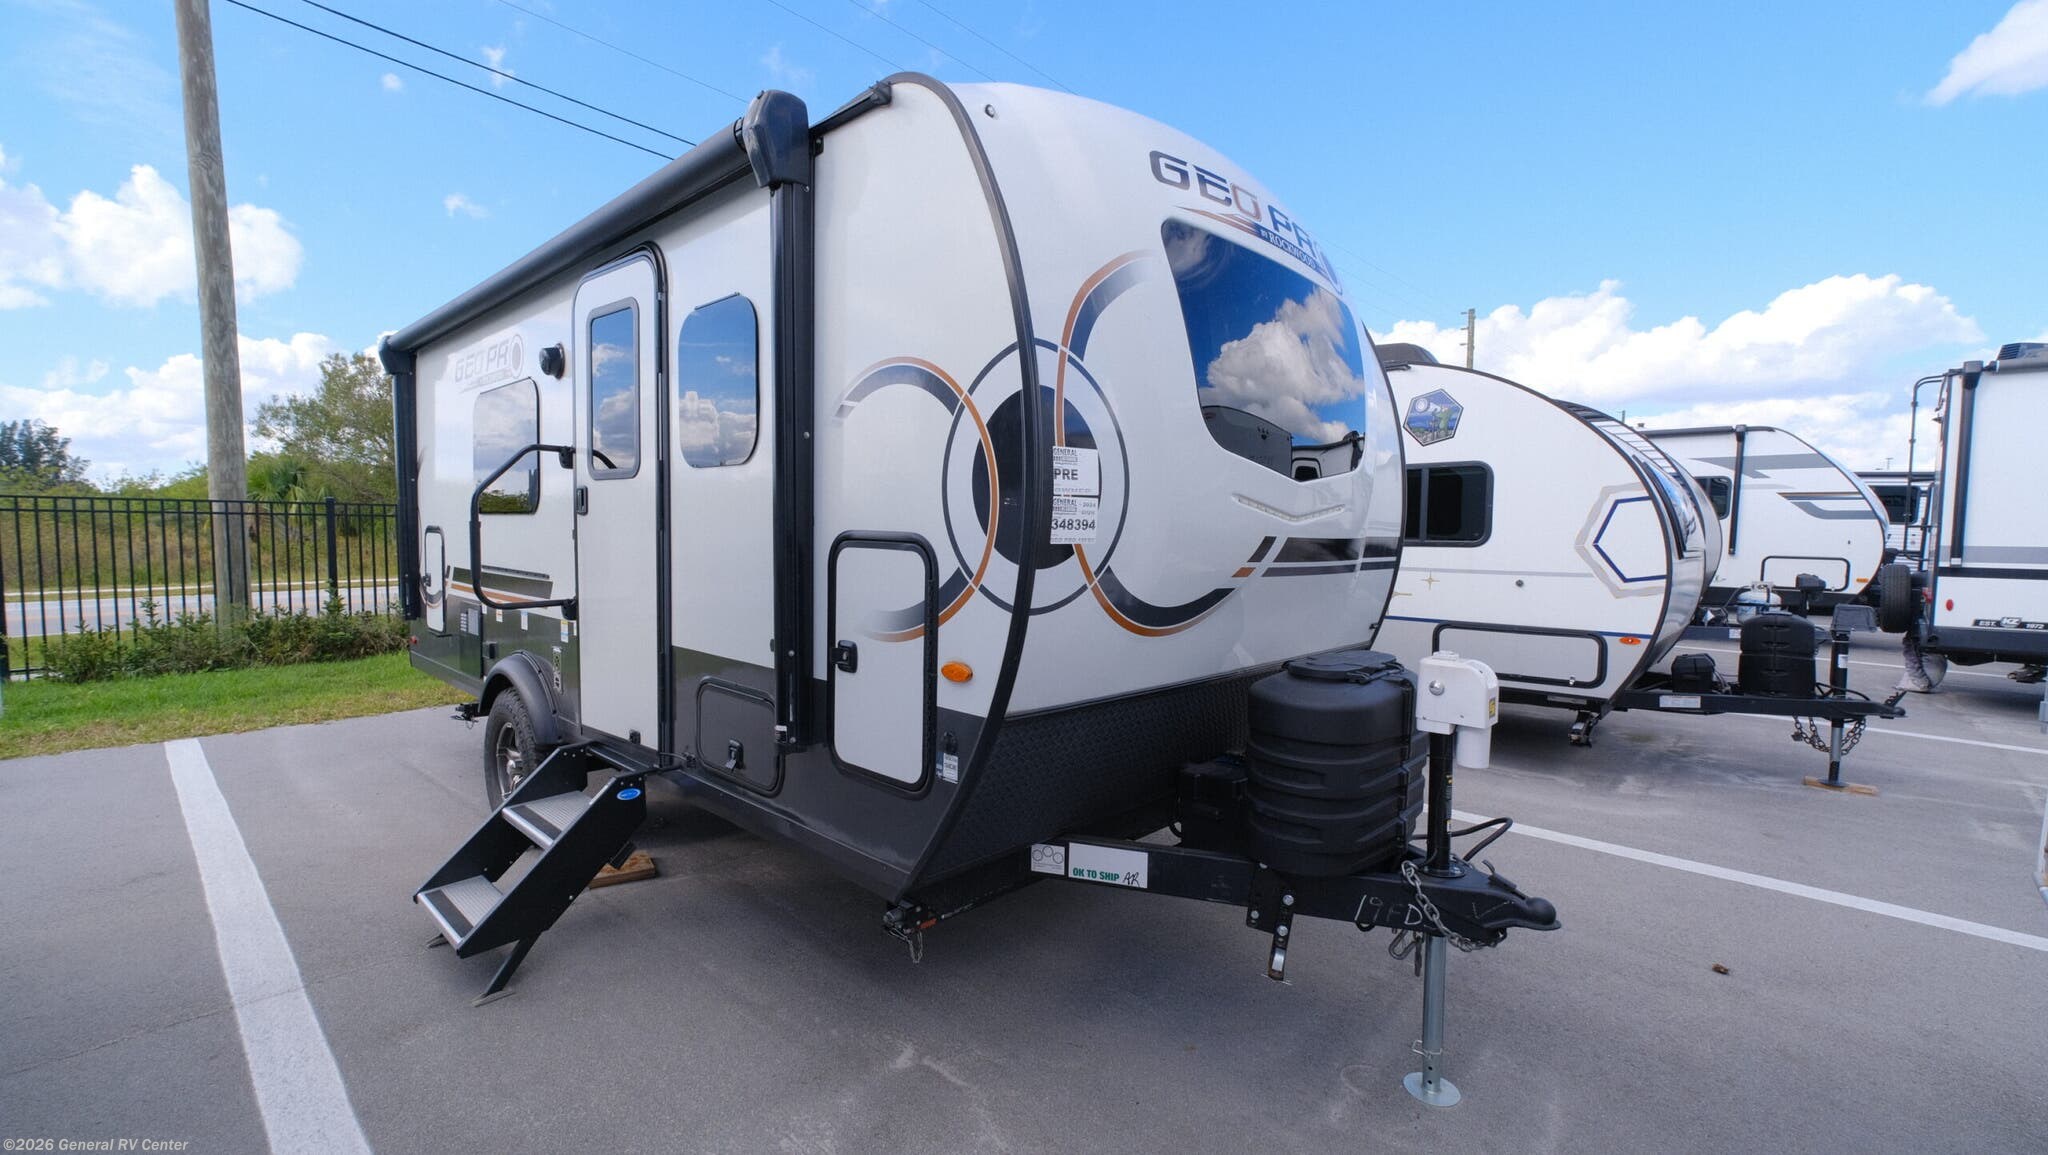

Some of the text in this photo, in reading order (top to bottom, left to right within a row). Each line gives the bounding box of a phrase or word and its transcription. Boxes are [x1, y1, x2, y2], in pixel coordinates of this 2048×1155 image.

[1149, 150, 1262, 222] GEO
[1269, 231, 1318, 270] ROCKWOOD
[455, 334, 524, 383] GEO PRO
[1054, 468, 1079, 480] PRE
[1051, 518, 1096, 530] 348394
[1073, 867, 1120, 882] OK TO SHIP
